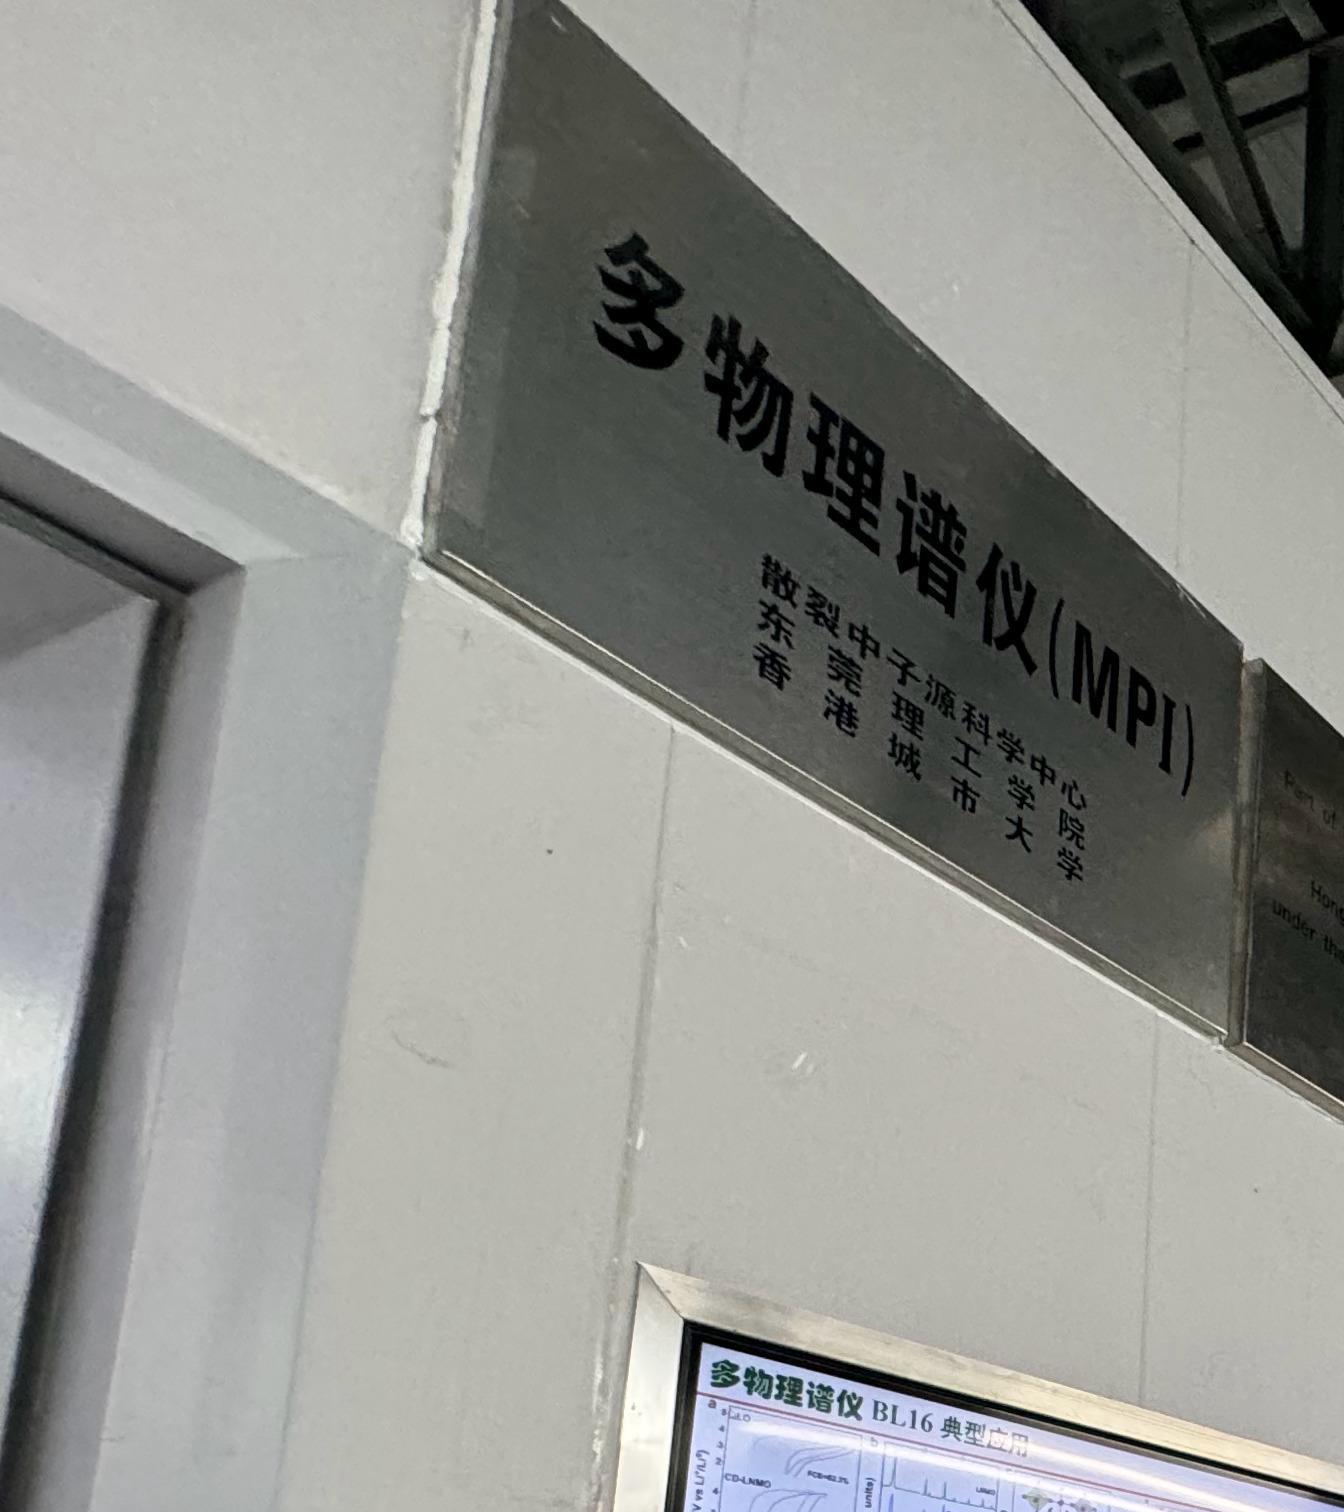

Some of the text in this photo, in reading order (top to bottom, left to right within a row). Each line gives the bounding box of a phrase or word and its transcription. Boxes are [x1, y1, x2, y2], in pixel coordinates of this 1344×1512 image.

[752, 641, 1084, 882] 香港城市大学
[757, 599, 1086, 851] 东莞理工学院
[760, 554, 1087, 810] 散裂中子源科学中心
[1272, 897, 1314, 942] under
[709, 1356, 865, 1422] 多物理谱仪
[870, 1397, 935, 1435] BL16
